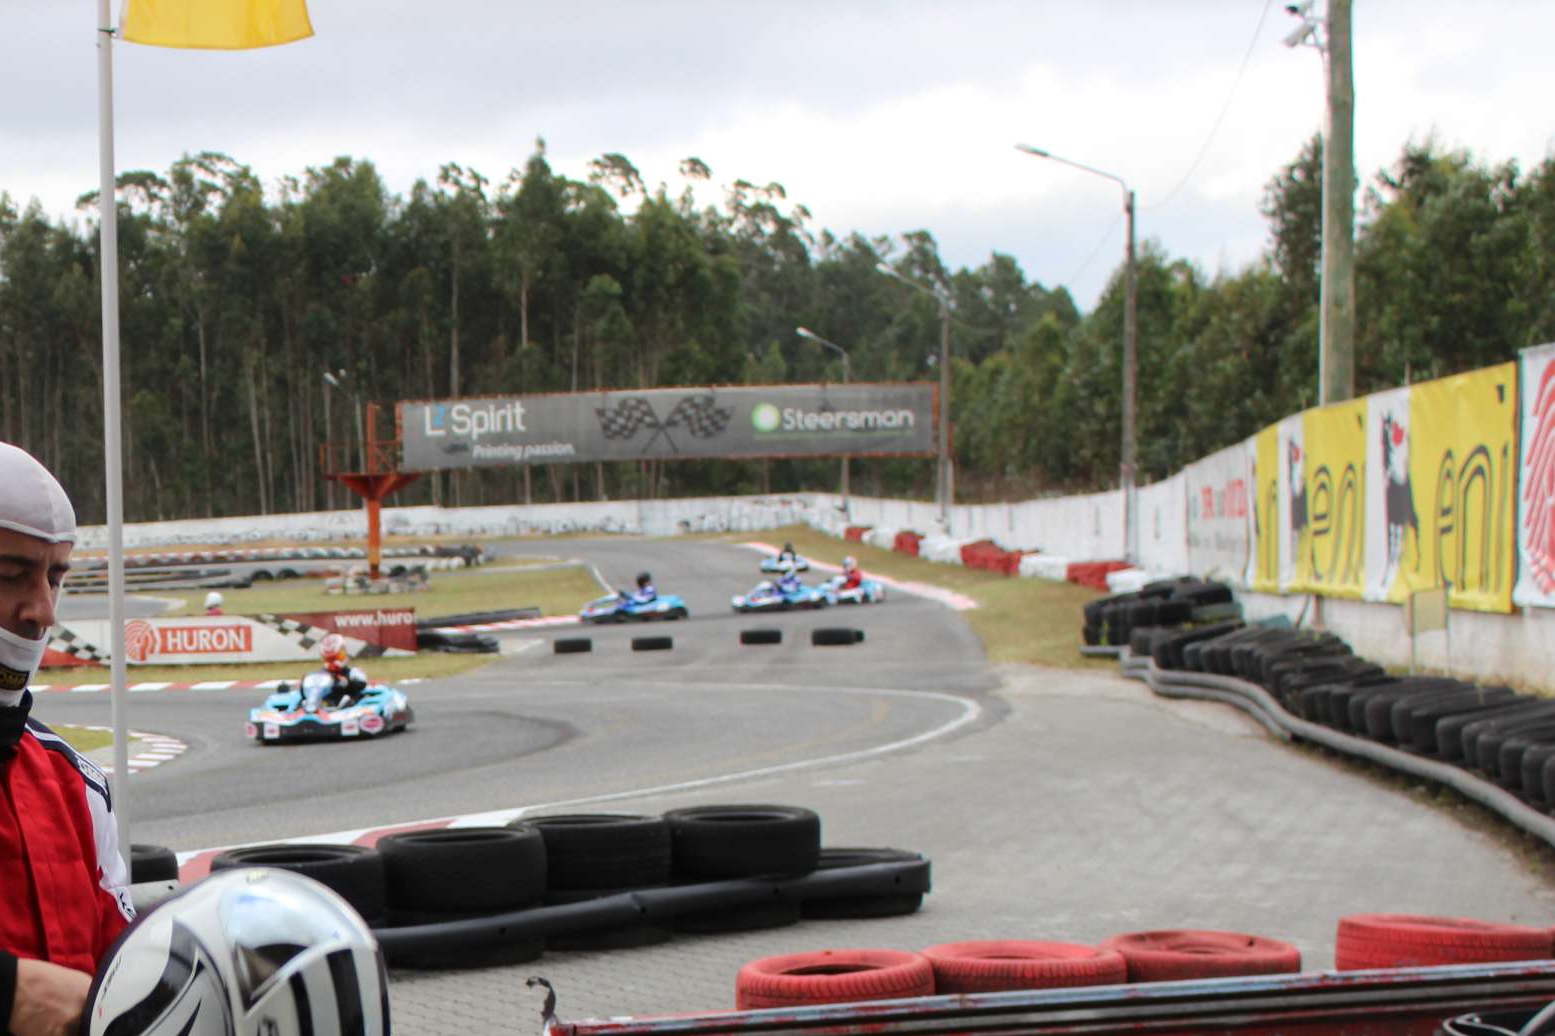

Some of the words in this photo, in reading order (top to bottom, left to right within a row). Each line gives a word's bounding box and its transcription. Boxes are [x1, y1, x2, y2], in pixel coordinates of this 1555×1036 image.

[451, 401, 526, 440] Spirit
[782, 408, 914, 431] Steersman
[335, 609, 416, 627] www.huro
[166, 629, 245, 653] HURON
